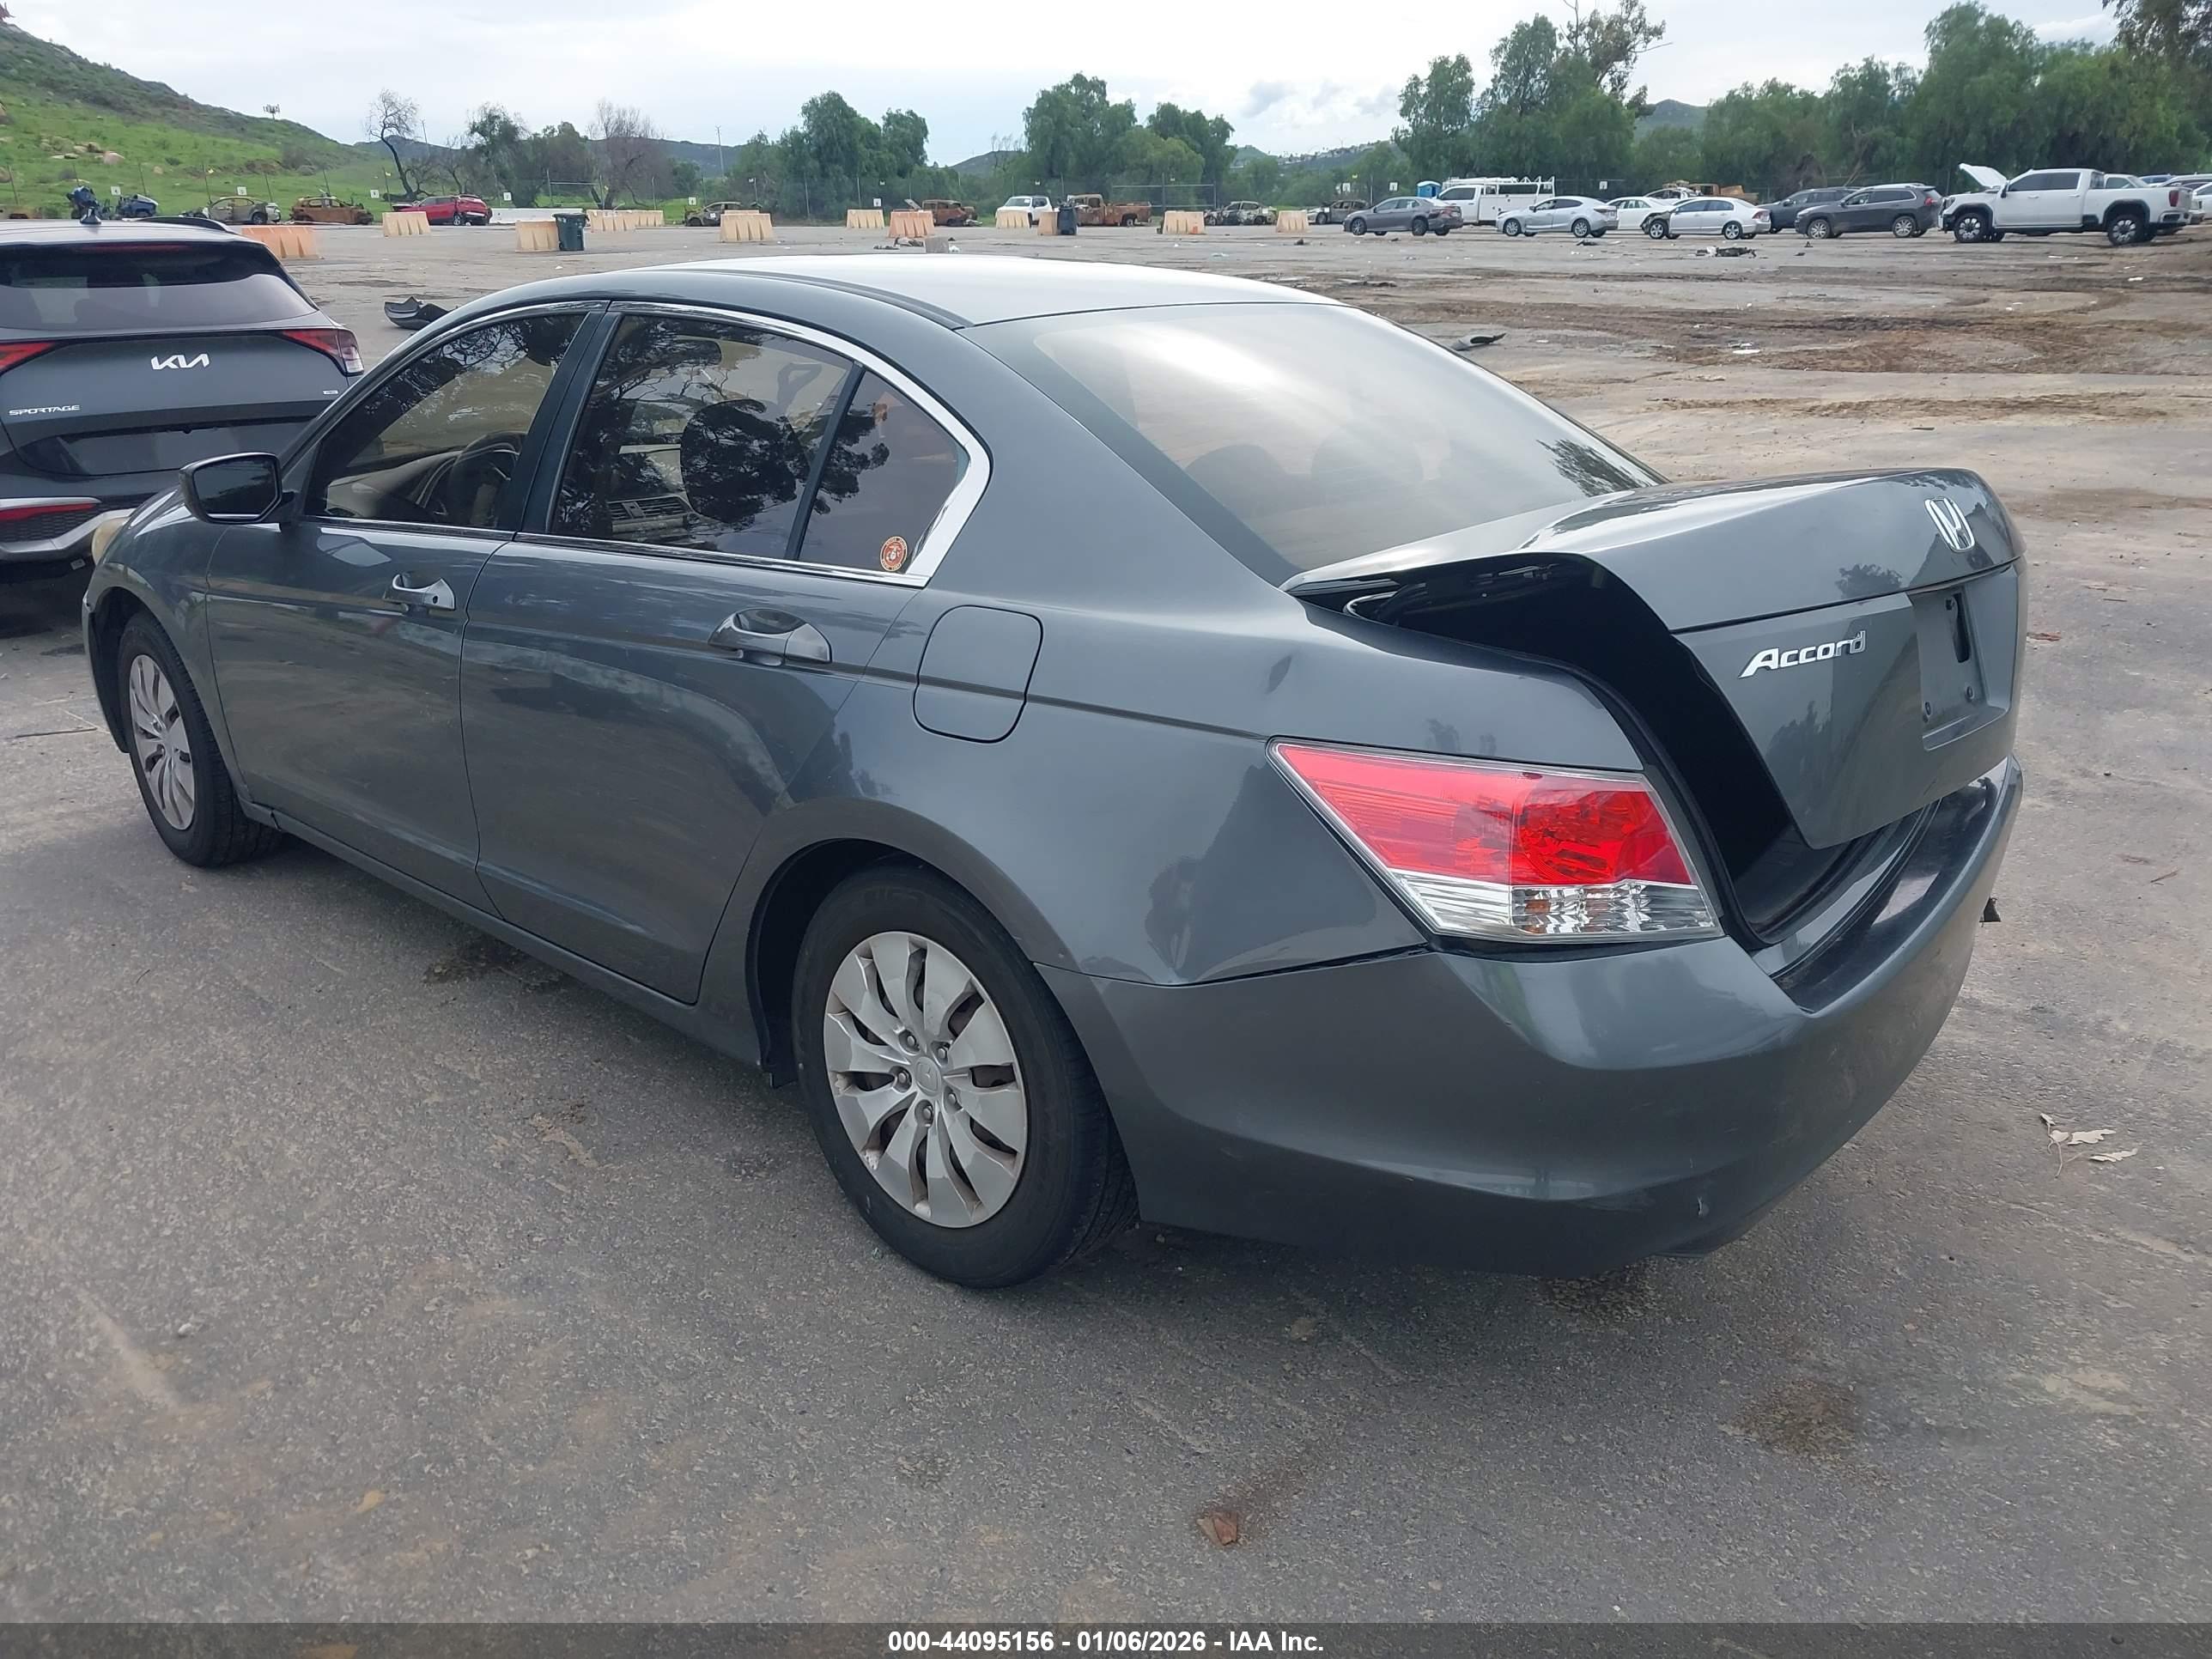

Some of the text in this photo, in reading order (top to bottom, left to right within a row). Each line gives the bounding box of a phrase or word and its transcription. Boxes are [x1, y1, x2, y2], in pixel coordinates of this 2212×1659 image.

[151, 353, 210, 370] KIA
[9, 404, 81, 416] SPORTAGE
[1737, 630, 1866, 678] Accord
